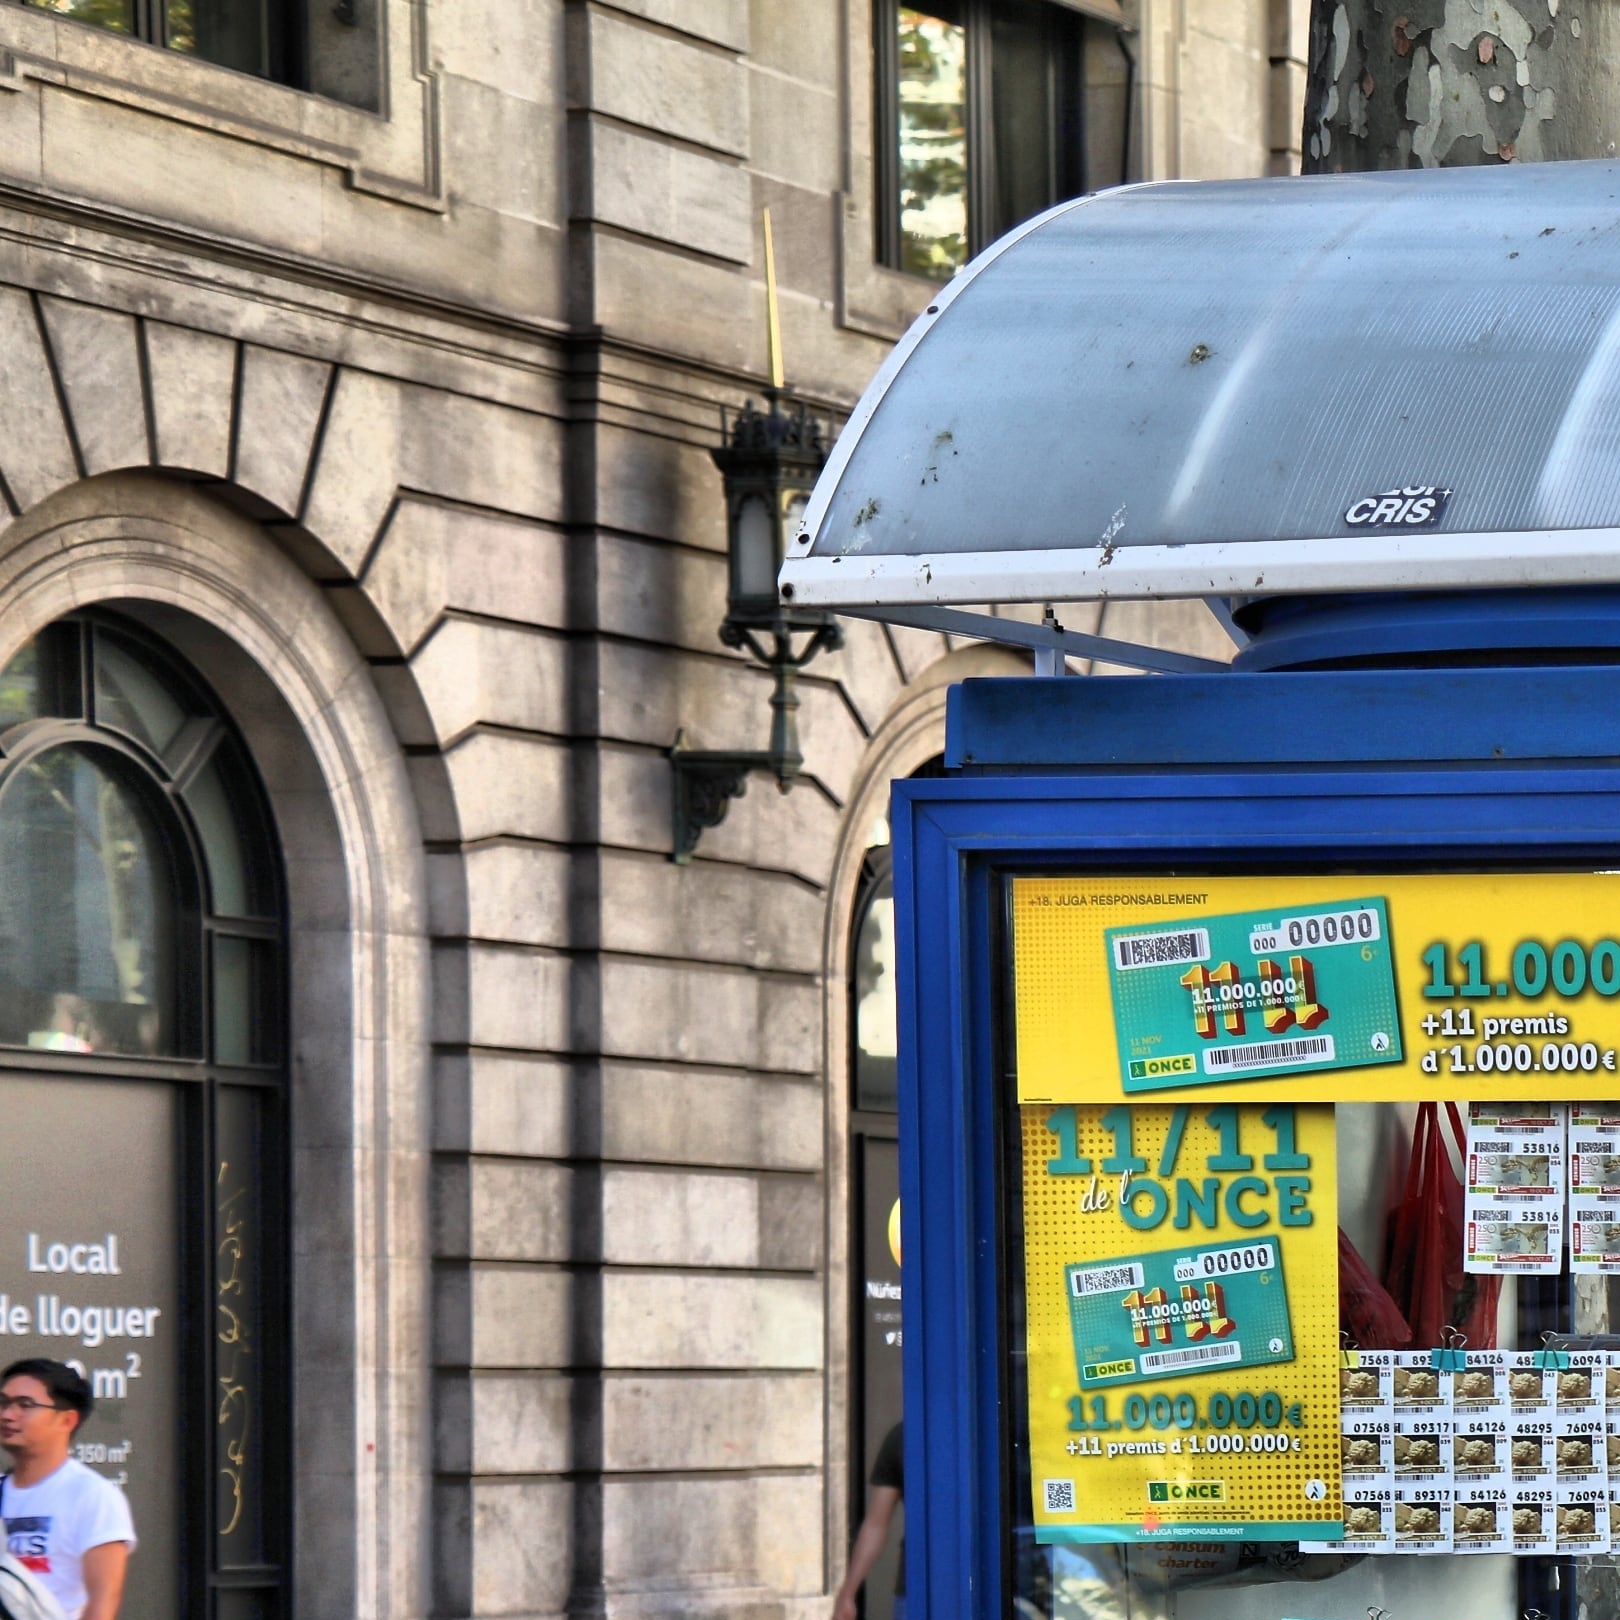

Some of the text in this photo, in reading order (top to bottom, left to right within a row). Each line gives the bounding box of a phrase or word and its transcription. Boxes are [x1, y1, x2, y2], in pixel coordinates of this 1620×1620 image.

[1345, 498, 1436, 523] CRIS
[1055, 895, 1087, 906] JUGA
[1090, 893, 1208, 906] RESPONSABLEMENT
[1288, 912, 1372, 947] 00000
[1253, 936, 1276, 951] 000
[1207, 1001, 1245, 1013] PREMIOS
[1246, 999, 1257, 1009] DE
[1421, 1008, 1568, 1038] +11 premis
[1148, 1057, 1192, 1074] ONCE
[1045, 1105, 1311, 1177] 11/11
[1522, 1142, 1560, 1154] 53816
[1081, 1176, 1110, 1213] de
[1521, 1210, 1559, 1222] 53816
[27, 1232, 122, 1275] Local
[1203, 1247, 1268, 1275] 00000
[38, 1295, 161, 1347] lloguer
[1466, 1354, 1504, 1366] 84126
[1098, 1361, 1132, 1375] ONCE
[1353, 1422, 1391, 1434] 07568
[1413, 1422, 1450, 1434] 89317
[1468, 1421, 1506, 1433] 84126
[1516, 1422, 1553, 1434] 48295
[1566, 1422, 1602, 1434] 76094
[1066, 1436, 1102, 1456] +11
[1107, 1438, 1166, 1459] premis
[1171, 1484, 1220, 1499] ONCE
[1516, 1490, 1553, 1502] 48295
[1151, 1528, 1172, 1536] JUGA
